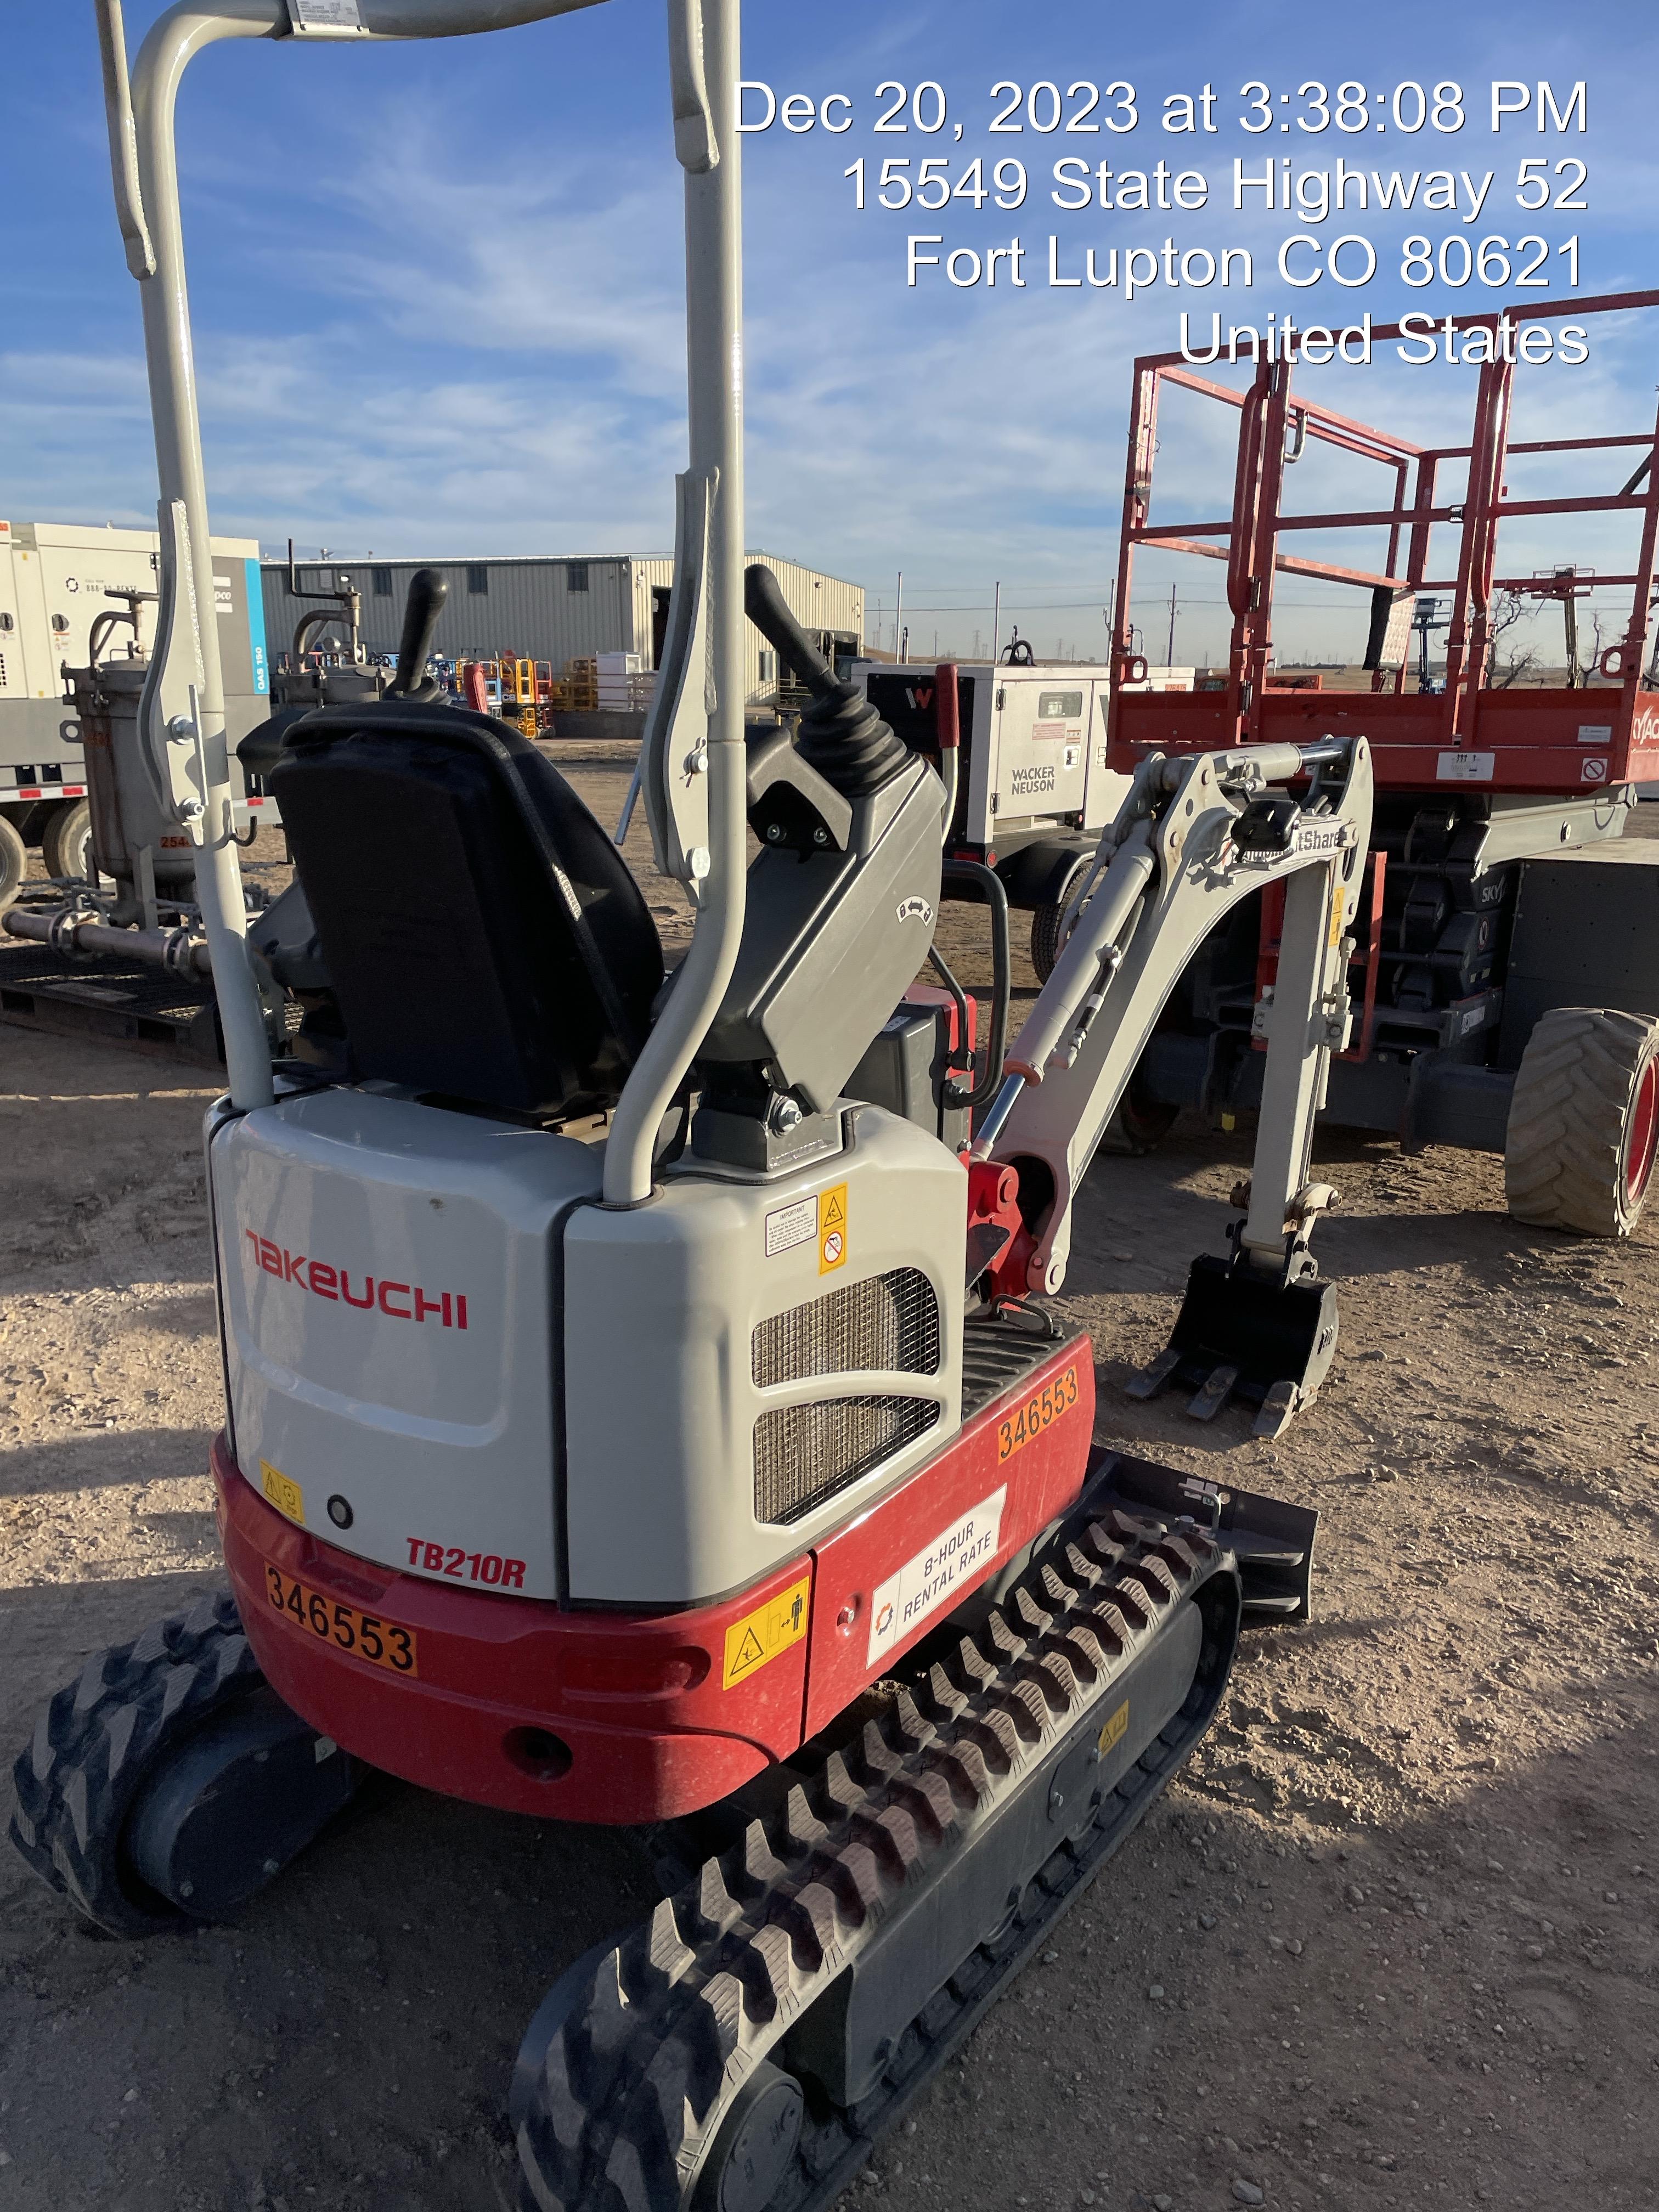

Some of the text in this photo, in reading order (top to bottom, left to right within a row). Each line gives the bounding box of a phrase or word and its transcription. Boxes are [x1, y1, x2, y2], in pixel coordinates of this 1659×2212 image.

[215, 591, 232, 602] pco
[255, 647, 263, 665] 150
[1012, 766, 1054, 781] WACKER
[1012, 779, 1054, 795] NEUSON
[780, 1205, 805, 1220] IMPORTANT
[1001, 1369, 1077, 1459] 346553
[407, 1537, 526, 1589] TB210R
[924, 1521, 974, 1578] 8-HOUR
[904, 1530, 992, 1623] RENTAL RATE
[268, 1567, 414, 1671] 346553
